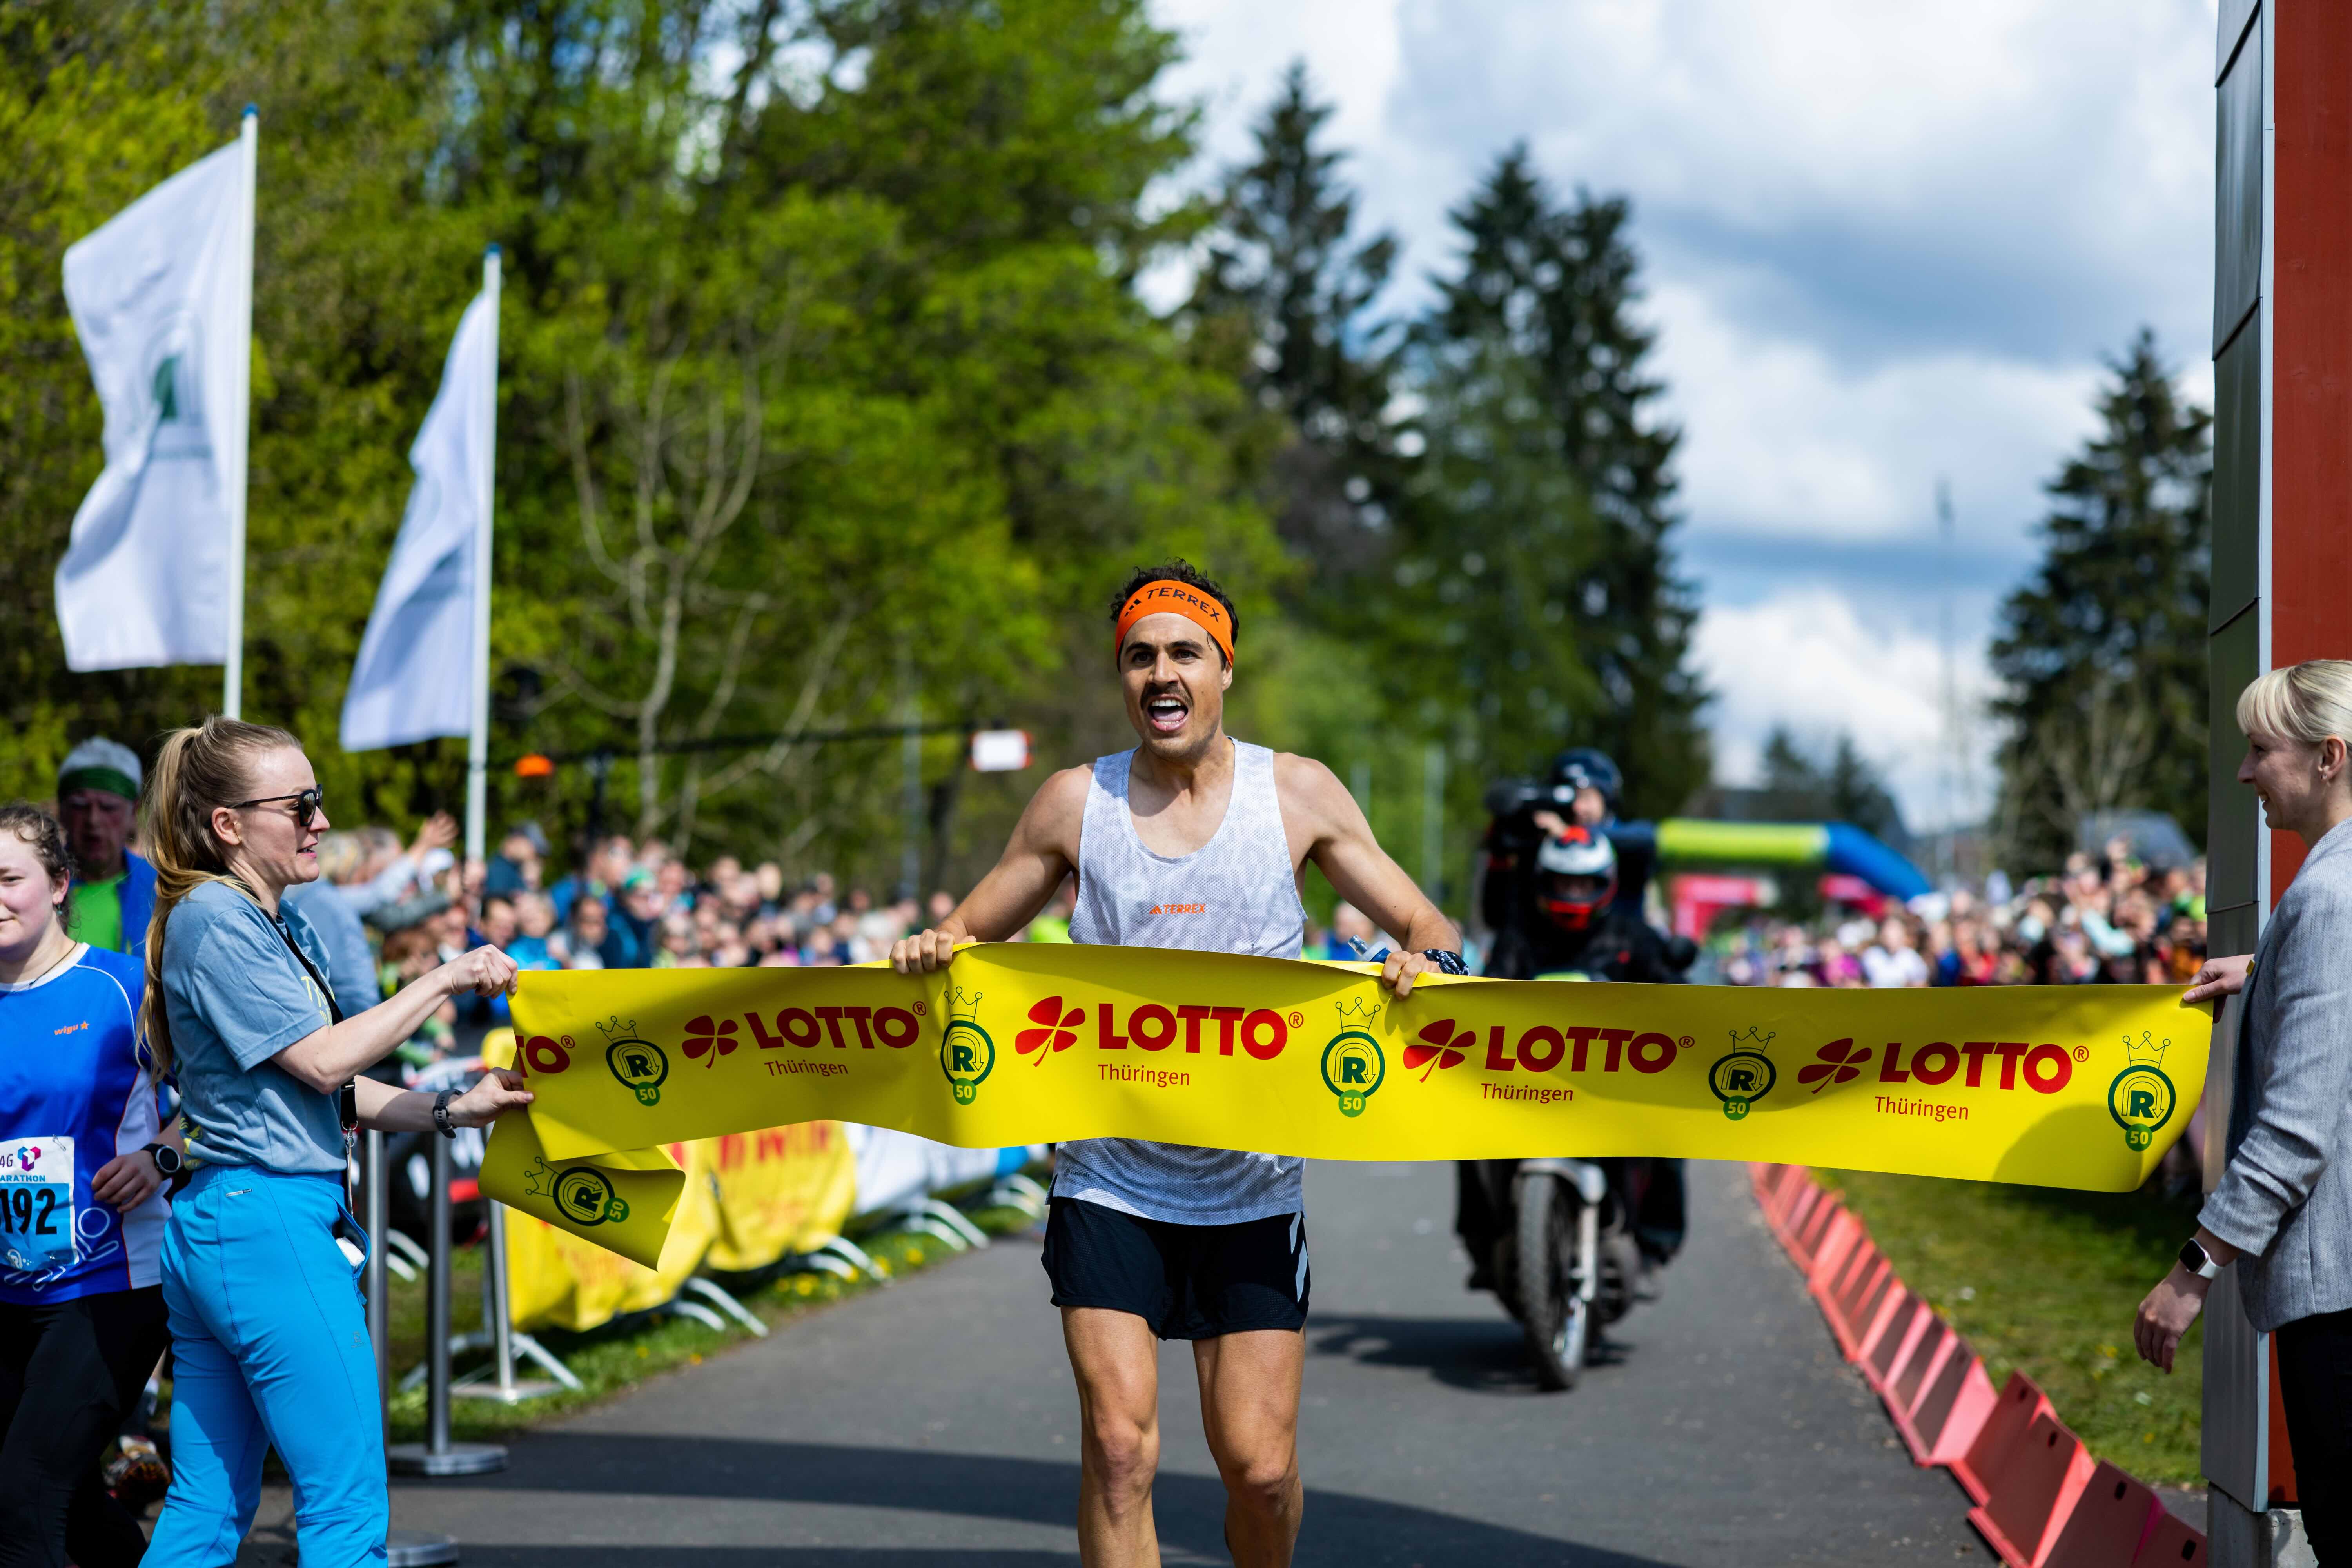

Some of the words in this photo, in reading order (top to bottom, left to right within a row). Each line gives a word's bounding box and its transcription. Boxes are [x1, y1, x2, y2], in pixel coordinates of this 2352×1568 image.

[1147, 587, 1220, 622] TERREX
[1163, 903, 1206, 914] TERREX
[625, 1055, 652, 1077] R
[764, 1059, 849, 1076] Thüringen
[952, 1045, 975, 1072] R
[1098, 1064, 1190, 1088] Thüringen
[1342, 1056, 1367, 1084] R
[1728, 1069, 1755, 1091] R
[639, 1088, 656, 1100] 50
[956, 1085, 973, 1098] 50
[1481, 1083, 1573, 1104] Thüringen
[1343, 1097, 1362, 1110] 50
[1727, 1102, 1747, 1114] 50
[1875, 1096, 1969, 1122] Thüringen
[2129, 1090, 2155, 1118] R
[2130, 1131, 2149, 1145] 50
[0, 1188, 57, 1236] 192
[610, 1201, 625, 1220] 50
